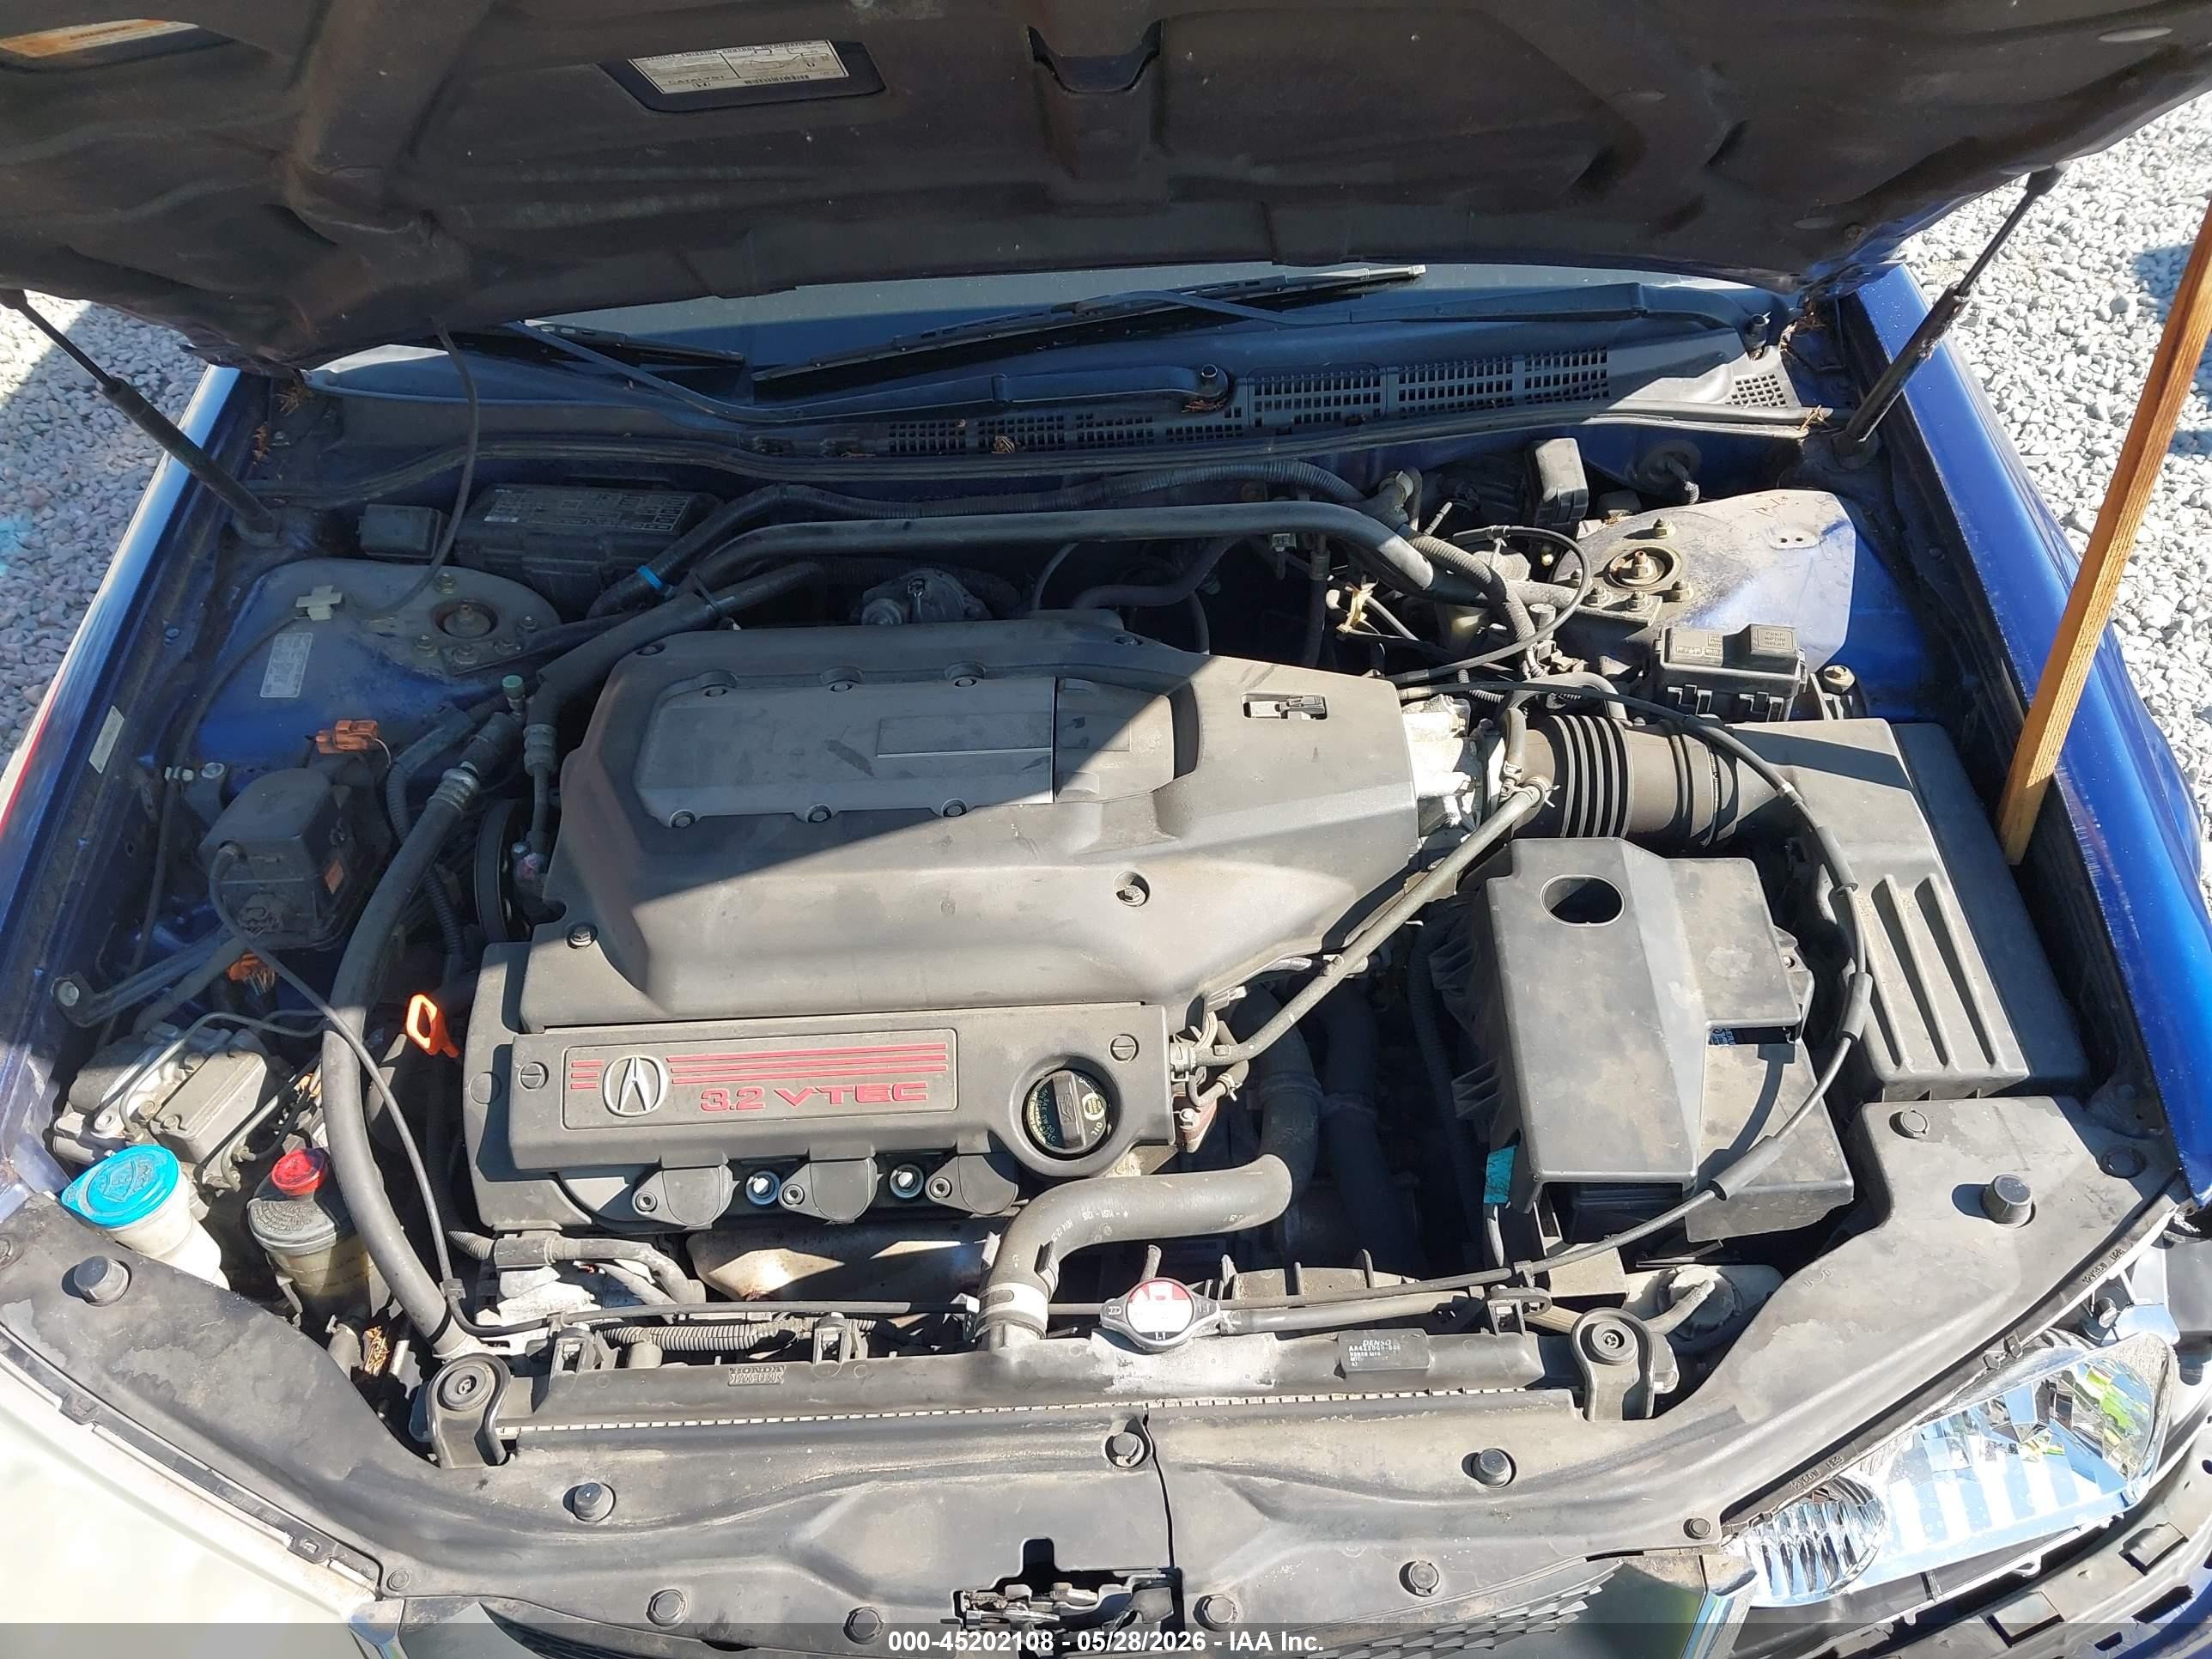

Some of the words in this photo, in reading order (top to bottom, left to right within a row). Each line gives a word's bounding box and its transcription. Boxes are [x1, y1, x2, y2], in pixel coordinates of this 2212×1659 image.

[668, 75, 725, 83] CATALYST
[700, 1085, 764, 1113] 3.2
[773, 1081, 929, 1107] VTEC
[1091, 1121, 1103, 1136] OIL
